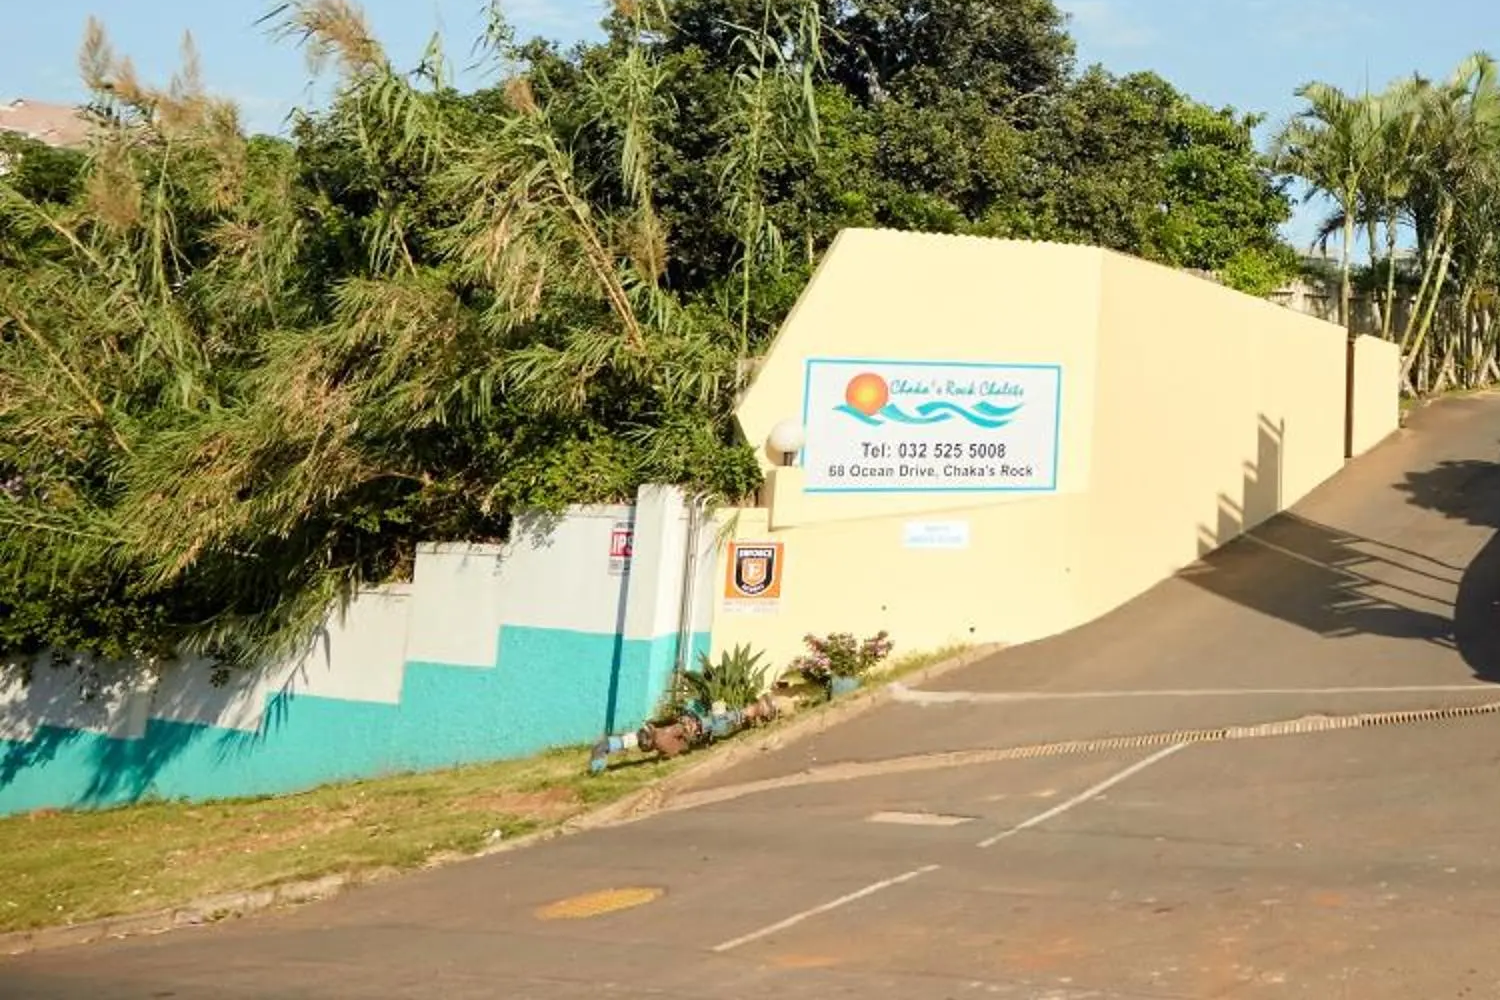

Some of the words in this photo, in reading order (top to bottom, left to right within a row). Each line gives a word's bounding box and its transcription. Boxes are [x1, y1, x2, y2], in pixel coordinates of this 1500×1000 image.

[861, 442, 892, 459] Tel:
[898, 442, 928, 459] 032
[933, 442, 963, 459] 525
[968, 442, 1007, 459] 5008
[828, 465, 845, 477] 68
[849, 465, 894, 478] Ocean
[899, 465, 940, 479] Drive,
[943, 465, 996, 478] Chaka's
[1001, 464, 1034, 478] Rock
